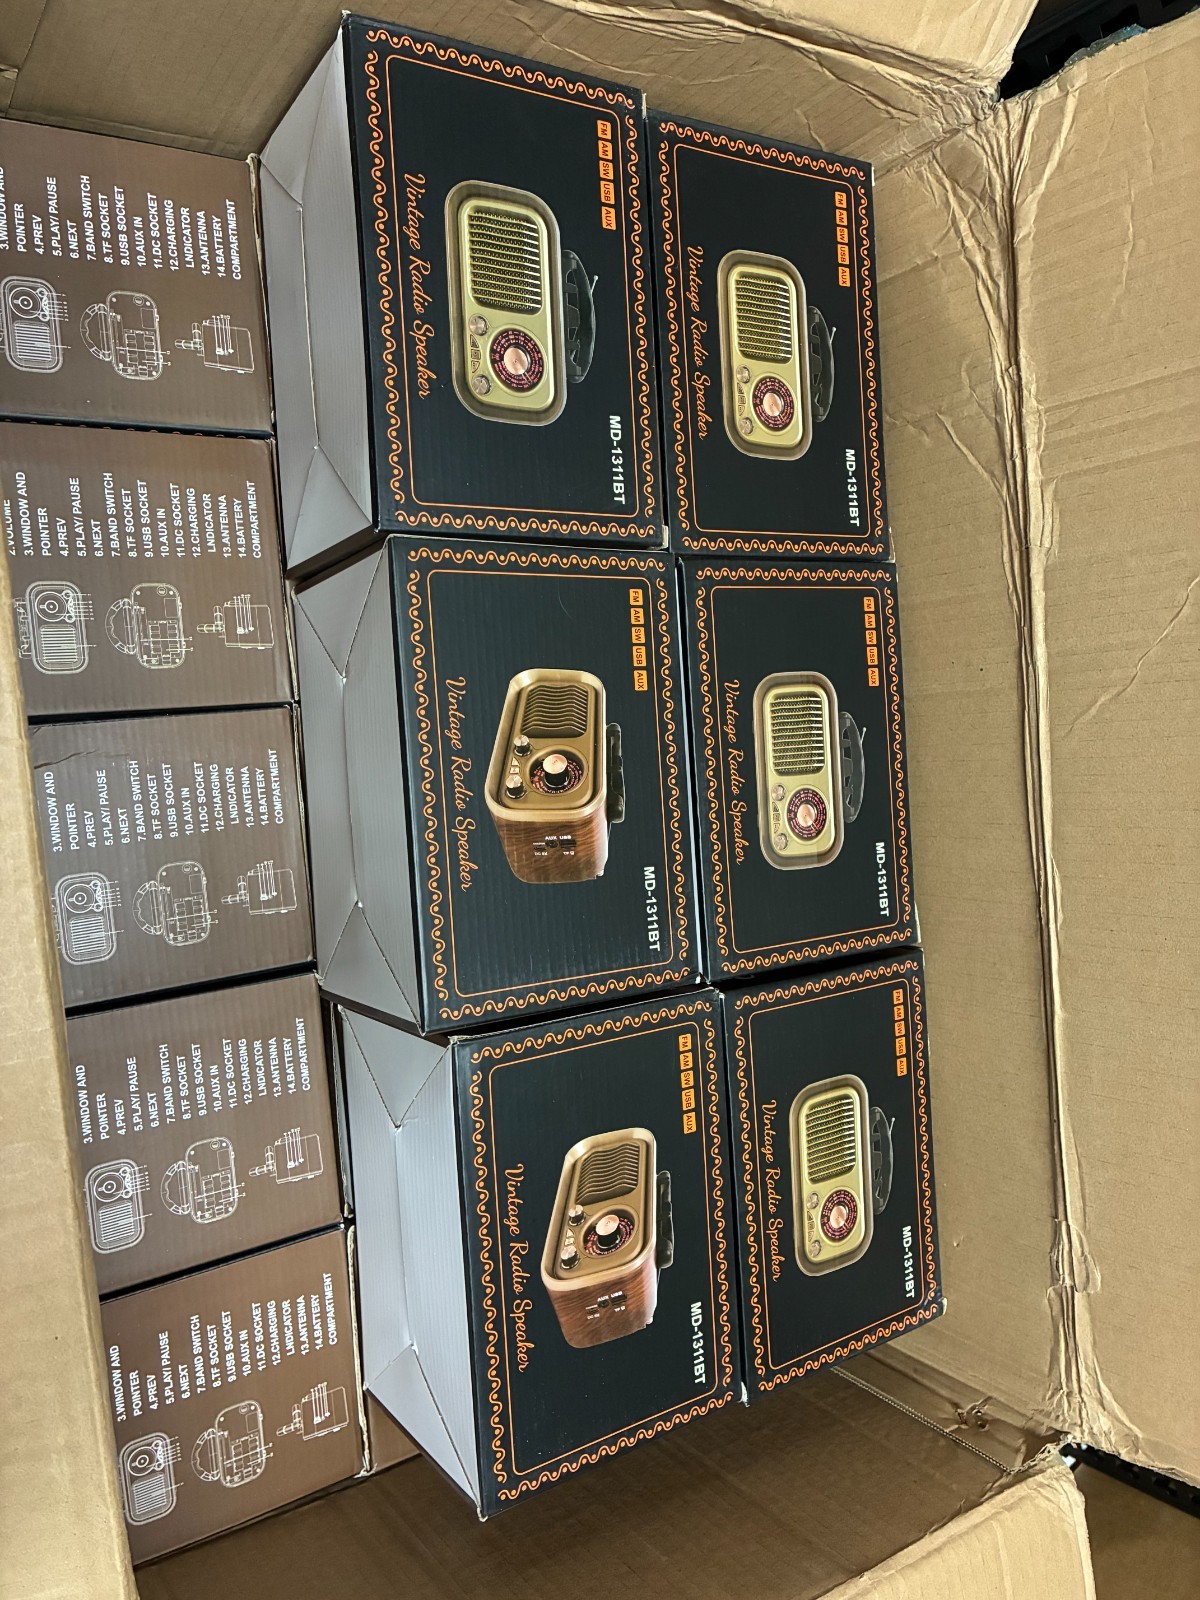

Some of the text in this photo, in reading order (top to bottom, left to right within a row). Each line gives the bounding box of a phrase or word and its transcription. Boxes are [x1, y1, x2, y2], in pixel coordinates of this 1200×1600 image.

[47, 177, 58, 214] PAUSE
[599, 122, 613, 228] FM AM SW USB AUX
[14, 204, 27, 252] POINTER
[32, 215, 44, 254] 4.PREV
[67, 220, 79, 258] 6.NEXT
[80, 175, 96, 260] 7.BAND SWITCH
[98, 193, 113, 263] 8.TF SOCKET
[114, 186, 130, 265] 9.USB SOCKET
[133, 217, 146, 266] 10.AUX IN
[147, 192, 163, 268] 11.DC SOCKET
[164, 200, 179, 271] 12.CHARGING
[181, 207, 194, 268] LNDICATOR
[197, 211, 210, 275] 13.ANTENNA
[212, 215, 226, 277] 14.BATTERY
[226, 199, 241, 280] COMPARTMENT
[836, 193, 848, 286] FM AM SW USB AUX
[403, 174, 437, 399] Vintage Radio Speaker
[686, 246, 712, 440] Vintage Radio Speaker
[610, 416, 625, 504] MD-1311BT
[846, 449, 859, 526] MD-1311BT
[16, 472, 34, 556] 3.WINDOW AND
[69, 478, 82, 514] PAUSE
[103, 473, 120, 557] 7.BAND SWITCH
[122, 488, 137, 557] 8.TF SOCKET
[137, 480, 153, 557] 9.USB SOCKET
[170, 483, 185, 557] 11.DC SOCKET
[186, 488, 201, 557] 12.CHARGING
[203, 494, 216, 552] LNDICATOR
[218, 495, 231, 558] 13.ANTENNA
[233, 498, 246, 558] 14.BATTERY
[246, 481, 261, 558] COMPARTMENT
[38, 508, 52, 556] POINTER
[56, 518, 69, 556] 4.PREV
[91, 519, 104, 556] 6.NEXT
[156, 508, 169, 557] 10.AUX IN
[632, 590, 645, 690] FM AM SW USB AUX
[96, 770, 109, 804] PAUSE
[129, 761, 146, 842] 7.BAND SWITCH
[162, 763, 178, 837] 9.USB SOCKET
[194, 762, 209, 833] 11.DC SOCKET
[210, 764, 224, 831] 12.CHARGING
[226, 767, 239, 824] LNDICATOR
[240, 766, 254, 827] 13.ANTENNA
[255, 768, 269, 825] 14.BATTERY
[268, 749, 284, 824] COMPARTMENT
[445, 677, 478, 892] Vintage Radio Speaker
[723, 680, 749, 865] Vintage Radio Speaker
[44, 772, 62, 852] 3.WINDOW AND
[66, 803, 80, 850] POINTER
[84, 811, 96, 848] 4.PREV
[118, 808, 130, 843] 6.NEXT
[147, 774, 162, 839] 8.TF SOCKET
[181, 788, 194, 835] 10.AUX IN
[644, 866, 660, 951] MD-1311BT
[876, 842, 889, 916] MD-1311BT
[127, 1057, 138, 1091] PAUSE
[159, 1044, 175, 1124] 7.BAND SWITCH
[176, 1056, 191, 1119] 8.TF SOCKET
[192, 1044, 207, 1116] 9.USB SOCKET
[222, 1039, 238, 1108] 11.DC SOCKET
[238, 1039, 252, 1104] 12.CHARGING
[254, 1040, 267, 1096] LNDICATOR
[268, 1037, 282, 1097] 13.ANTENNA
[283, 1038, 296, 1094] 14.BATTERY
[296, 1018, 310, 1090] COMPARTMENT
[681, 1035, 694, 1132] FM AM SW USB AUX
[76, 1065, 93, 1144] 3.WINDOW AND
[96, 1093, 110, 1140] POINTER
[114, 1100, 126, 1135] 4.PREV
[147, 1092, 159, 1127] 6.NEXT
[761, 1100, 785, 1282] Vintage Radio Speaker
[503, 1164, 534, 1372] Vintage Radio Speaker
[903, 1226, 914, 1298] MD-1311BT
[252, 1303, 266, 1371] 11.DC SOCKET
[267, 1300, 281, 1365] 12.CHARGING
[282, 1299, 295, 1356] LNDICATOR
[296, 1295, 309, 1355] 13.ANTENNA
[311, 1295, 323, 1350] 14.BATTERY
[323, 1273, 337, 1345] COMPARTMENT
[691, 1302, 705, 1383] MD-1311BT
[159, 1331, 170, 1366] PAUSE
[190, 1315, 206, 1394] 7.BAND SWITCH
[207, 1325, 221, 1387] 8.TF SOCKET
[222, 1311, 236, 1382] 9.USB SOCKET
[110, 1346, 126, 1422] 3.WINDOW AND
[129, 1370, 142, 1416] POINTER
[146, 1375, 158, 1409] 4.PREV
[178, 1365, 190, 1398] 6.NEXT
